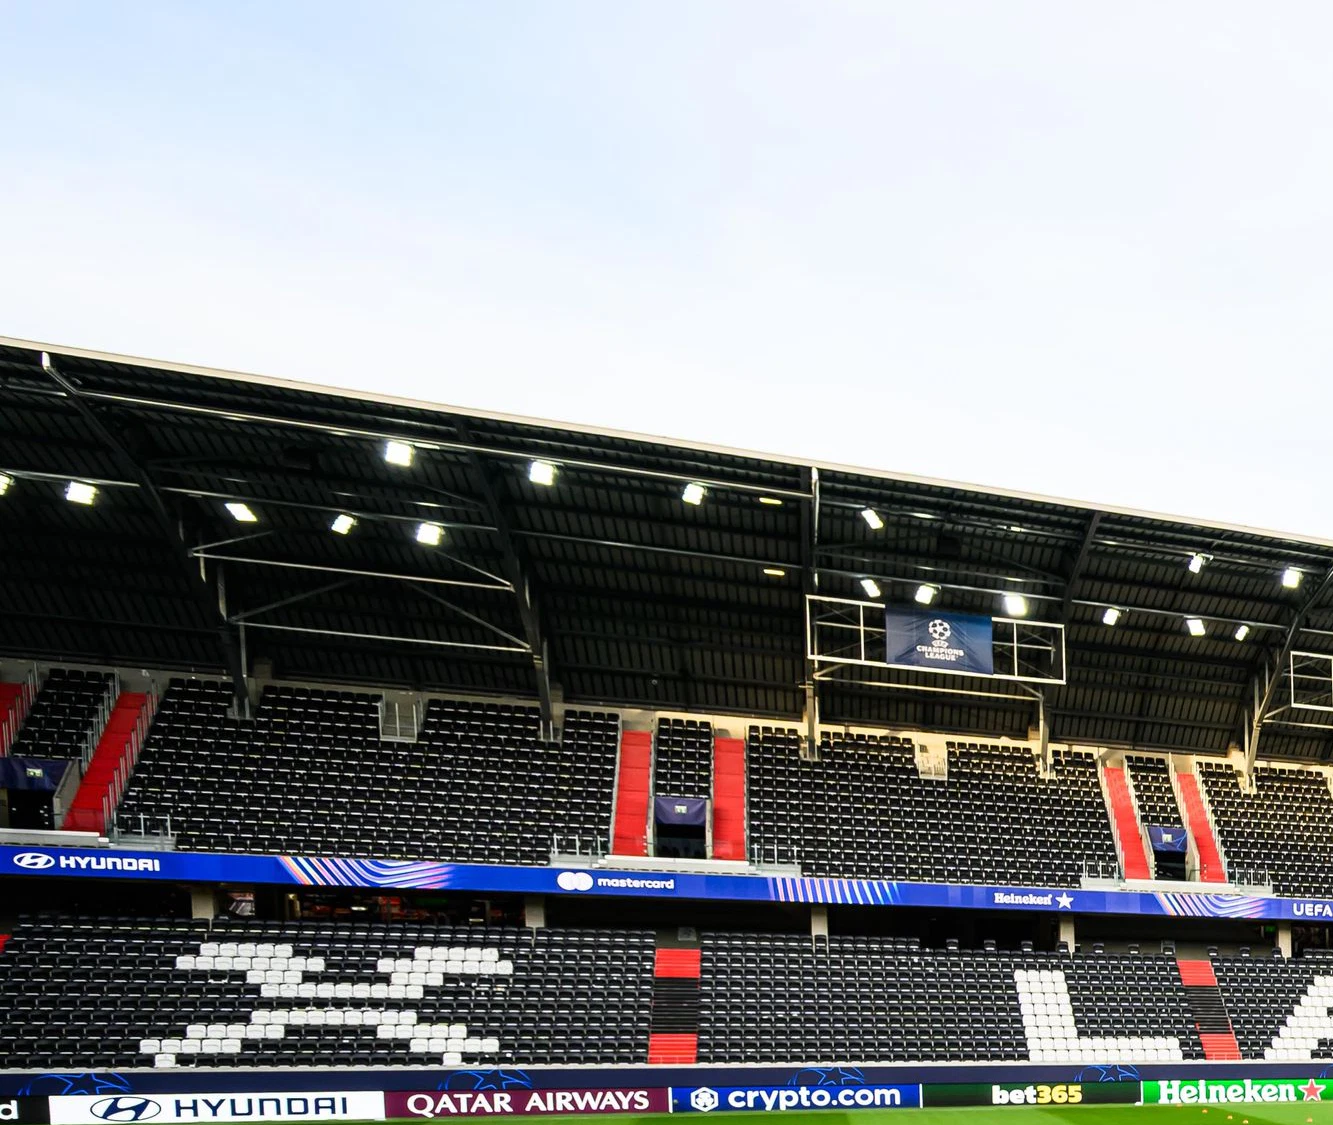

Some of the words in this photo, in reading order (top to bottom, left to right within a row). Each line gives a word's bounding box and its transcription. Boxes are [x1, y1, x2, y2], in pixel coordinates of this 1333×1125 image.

[916, 645, 964, 656] CHAMPIONS
[925, 652, 956, 661] LEAGUE
[59, 855, 160, 872] HYUNDAI
[598, 877, 674, 890] mastercard
[1293, 902, 1333, 916] UEFA
[727, 1086, 900, 1112] crypto.com
[991, 1085, 1083, 1105] bet365
[1158, 1079, 1297, 1105] Heineken
[175, 1096, 348, 1118] HYUNDAI
[406, 1092, 514, 1118] QATAR
[525, 1090, 650, 1112] AIRWAYS
